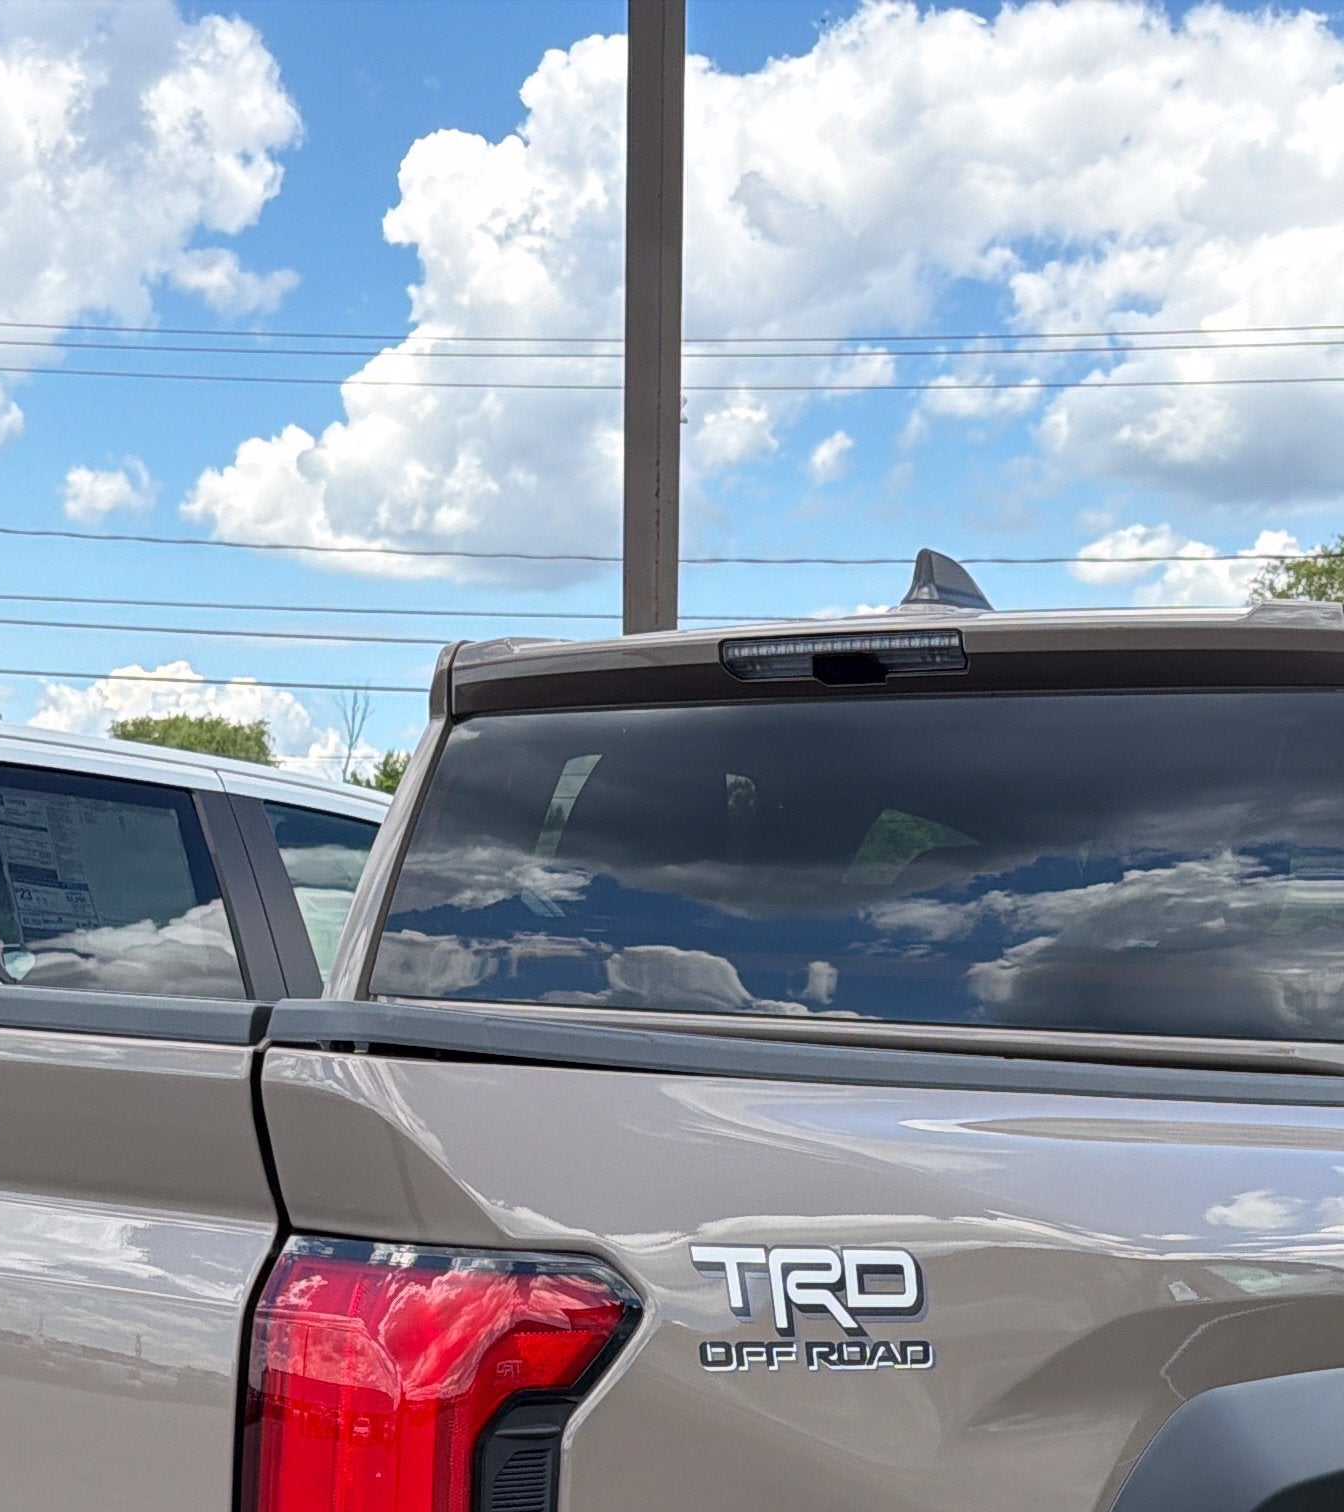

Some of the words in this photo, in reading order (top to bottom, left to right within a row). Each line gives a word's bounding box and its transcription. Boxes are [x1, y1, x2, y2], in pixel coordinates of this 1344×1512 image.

[689, 1244, 928, 1338] TRD
[699, 1340, 797, 1371] OFF
[805, 1340, 934, 1370] ROAD
